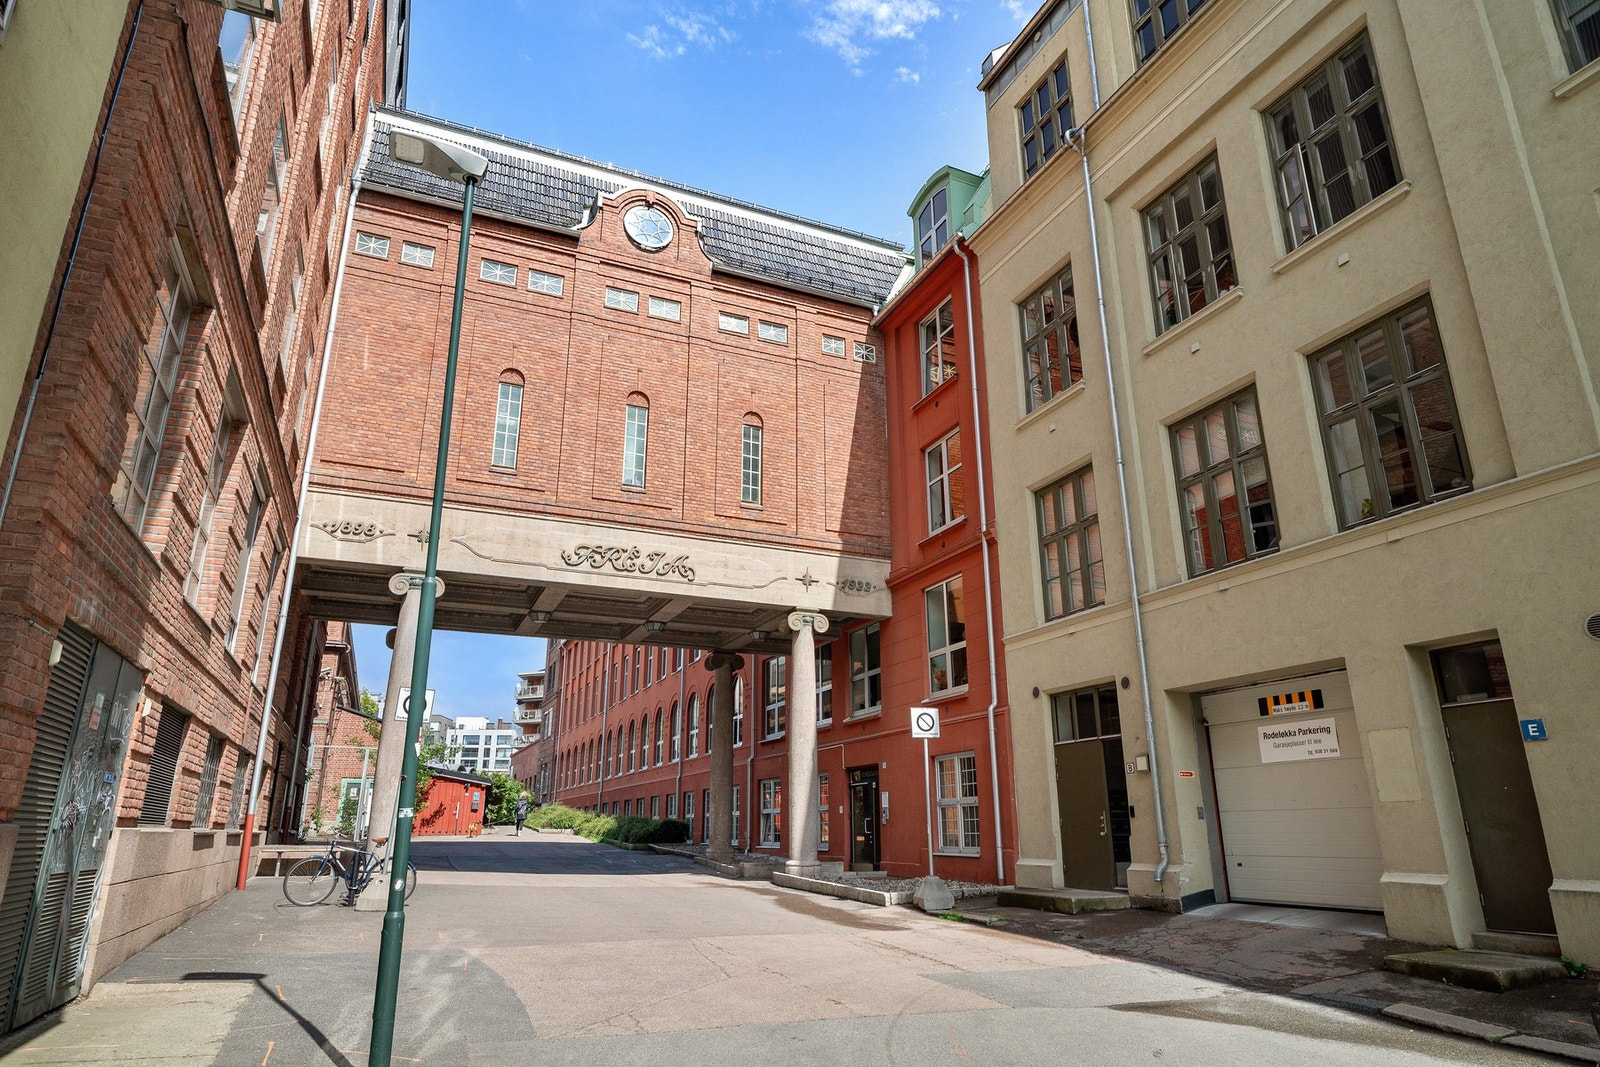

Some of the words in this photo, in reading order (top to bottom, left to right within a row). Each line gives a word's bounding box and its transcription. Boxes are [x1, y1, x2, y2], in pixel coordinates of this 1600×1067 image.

[330, 521, 377, 537] 1898
[561, 544, 696, 582] FREIA
[840, 578, 872, 593] 1922
[1263, 730, 1297, 740] Rodeløkka
[1298, 725, 1331, 735] Parkering
[1527, 723, 1540, 736] E
